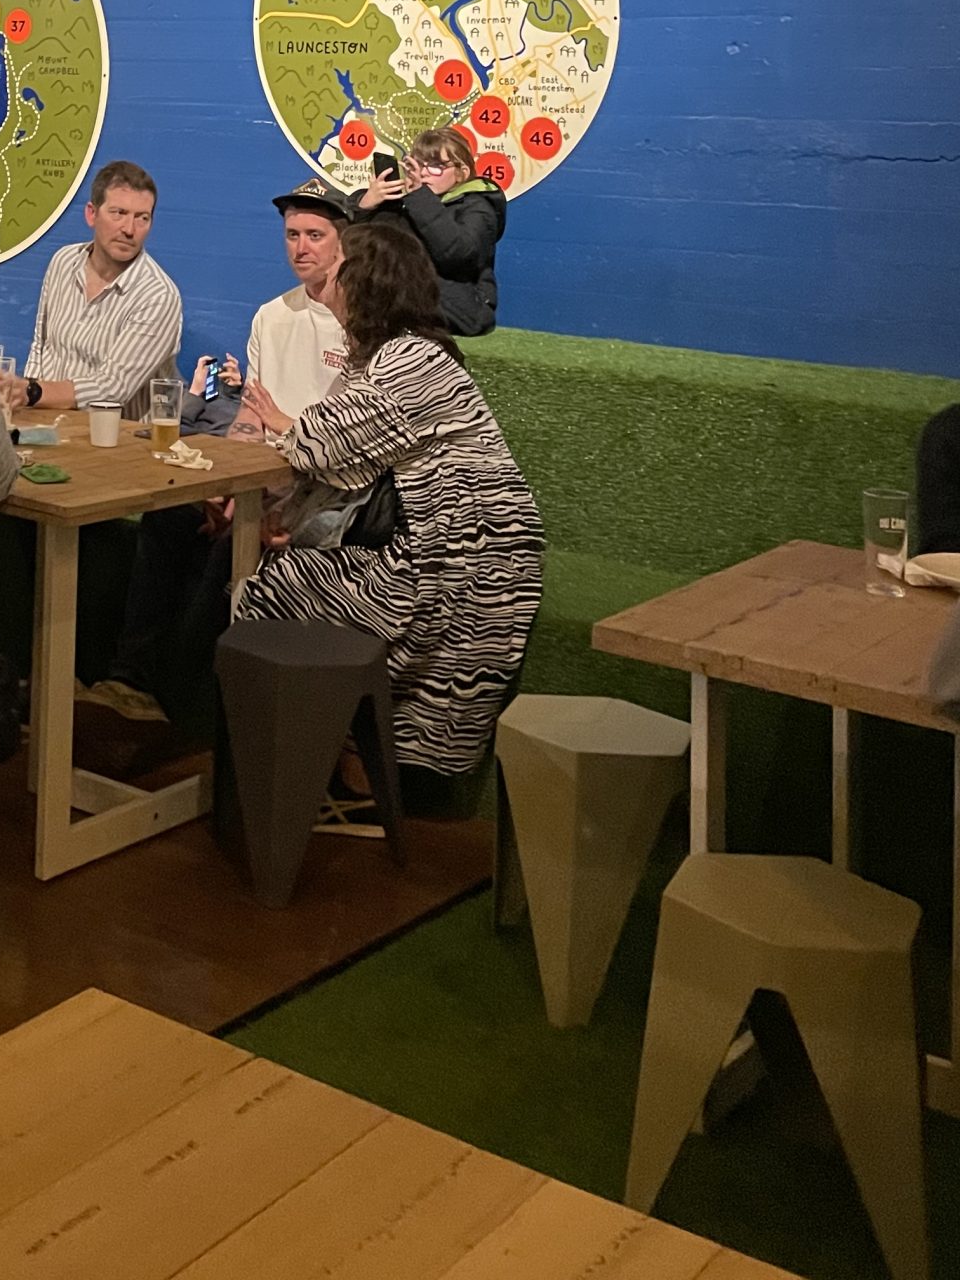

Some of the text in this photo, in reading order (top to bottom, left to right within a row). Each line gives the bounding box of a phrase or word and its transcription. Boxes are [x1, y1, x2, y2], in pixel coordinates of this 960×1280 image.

[11, 20, 25, 32] 37
[466, 16, 512, 26] Invermay
[278, 40, 368, 55] LAUNCESTON
[405, 51, 445, 63] Trevallyn
[444, 73, 463, 88] 41
[498, 77, 516, 86] CBD
[541, 76, 559, 84] East
[541, 105, 586, 114] Newstead
[478, 109, 502, 124] 42
[346, 133, 368, 148] 40
[529, 131, 554, 147] 46
[484, 142, 505, 152] West
[482, 165, 505, 180] 45
